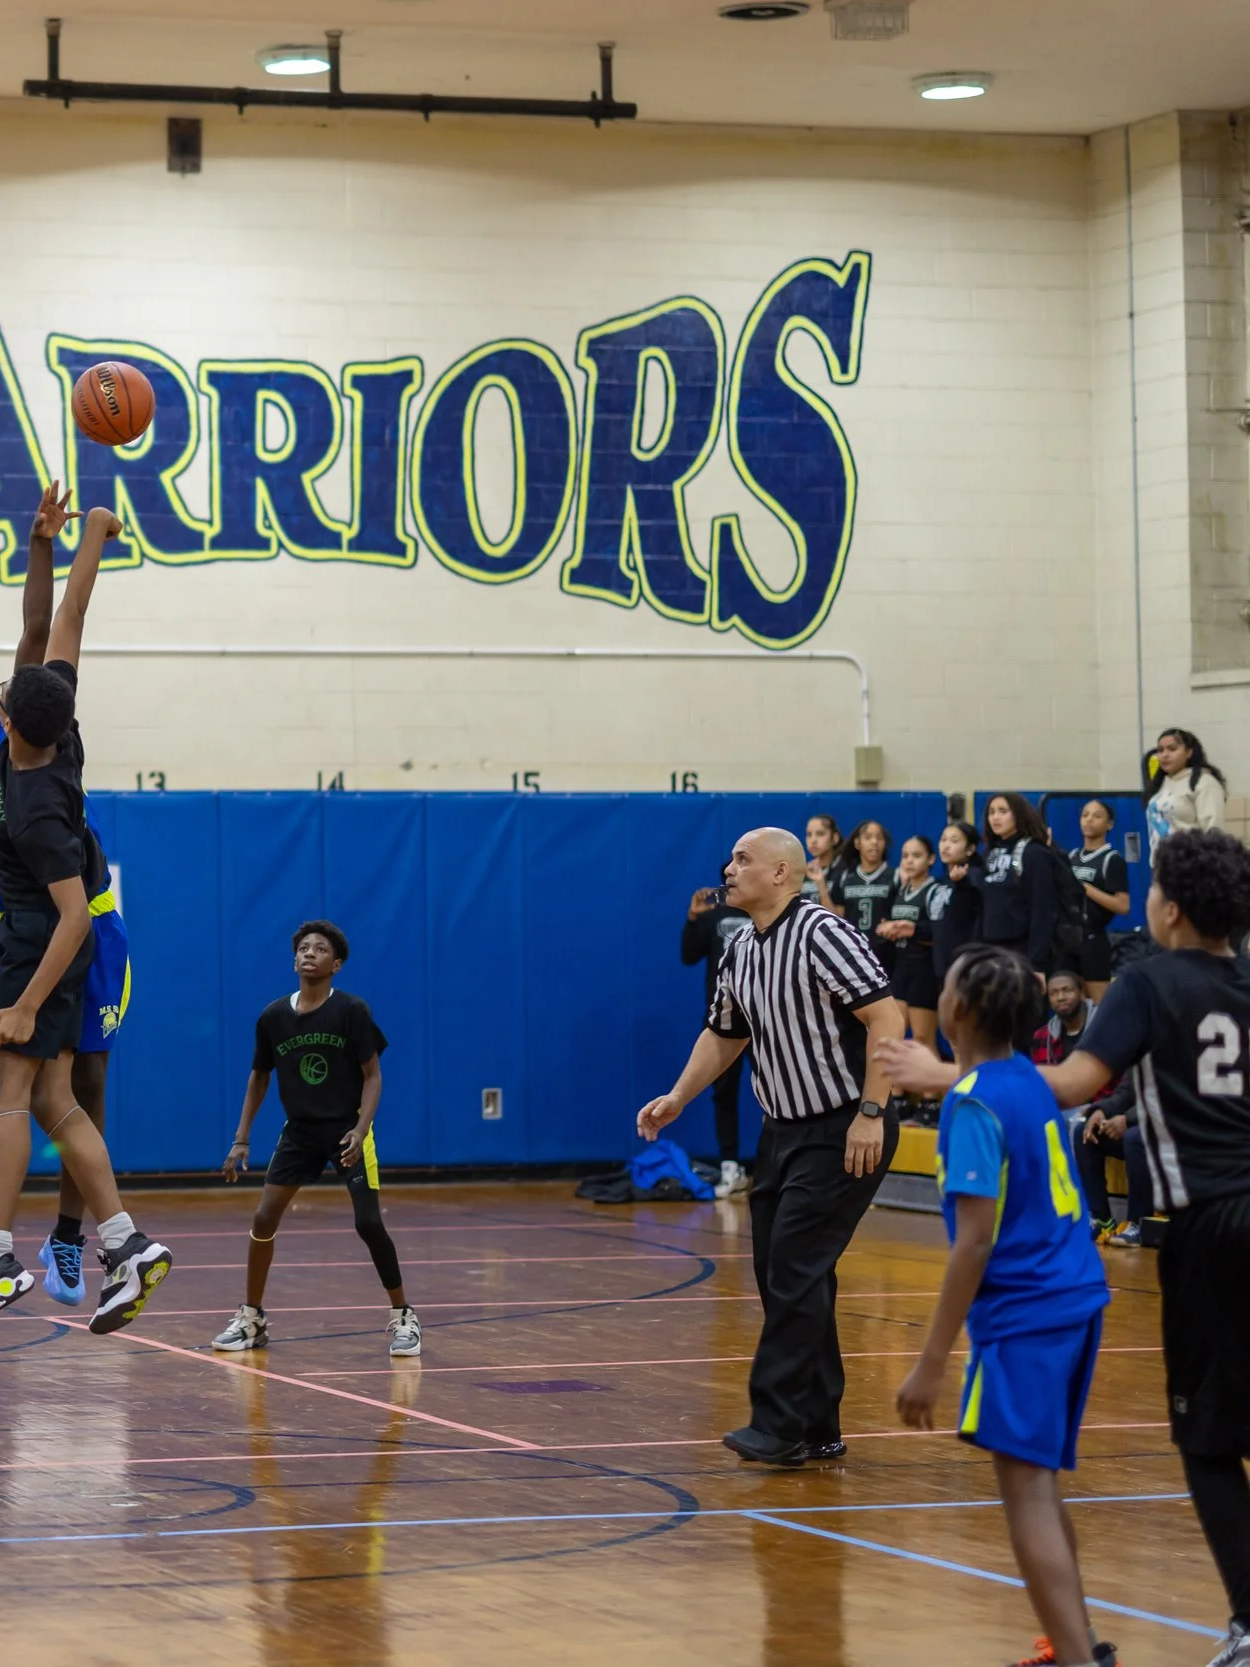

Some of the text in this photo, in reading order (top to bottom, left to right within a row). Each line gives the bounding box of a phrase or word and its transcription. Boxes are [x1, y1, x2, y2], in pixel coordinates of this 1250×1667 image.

[97, 367, 120, 416] Wilson
[136, 771, 166, 791] 13
[317, 770, 345, 791] 14
[512, 771, 540, 792] 15
[858, 899, 872, 930] 3
[276, 1032, 347, 1056] EVERGREEN
